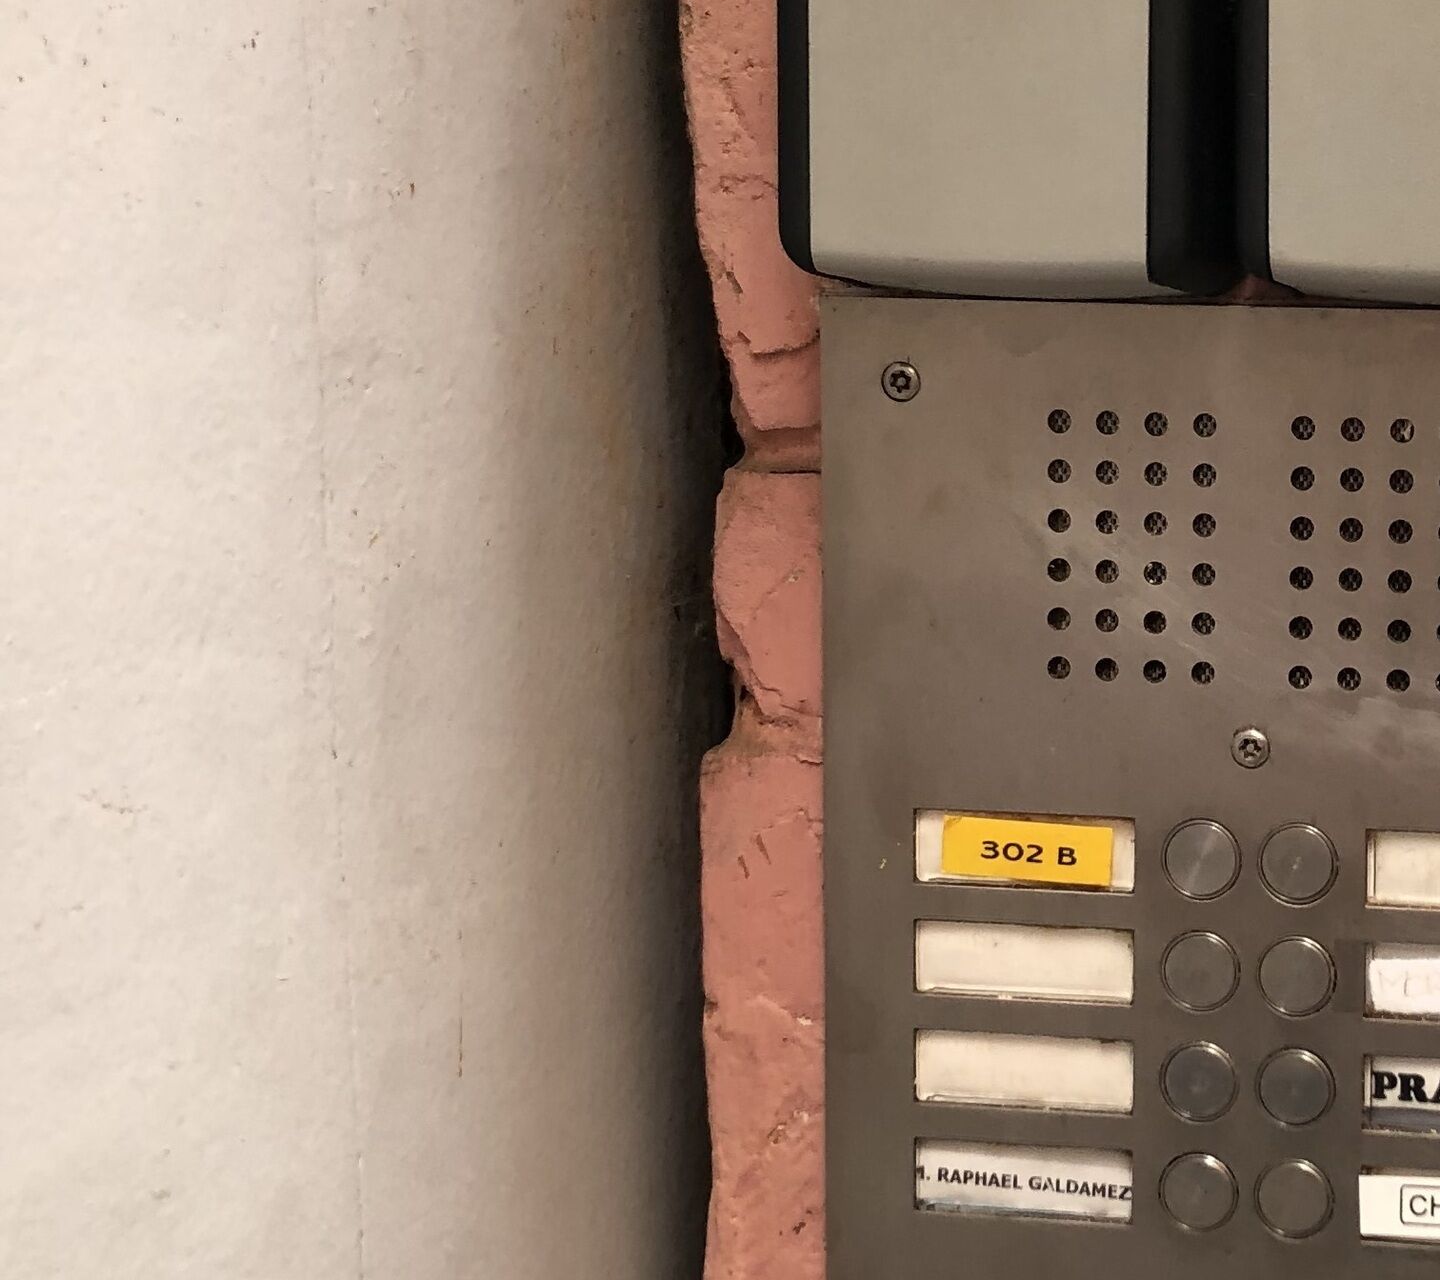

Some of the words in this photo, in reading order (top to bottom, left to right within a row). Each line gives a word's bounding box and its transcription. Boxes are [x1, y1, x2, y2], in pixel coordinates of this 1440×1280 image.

[980, 840, 1043, 864] 302
[1057, 846, 1078, 866] B
[937, 1166, 1023, 1190] RAPHAEL
[1028, 1176, 1133, 1201] GALDAMEZ
